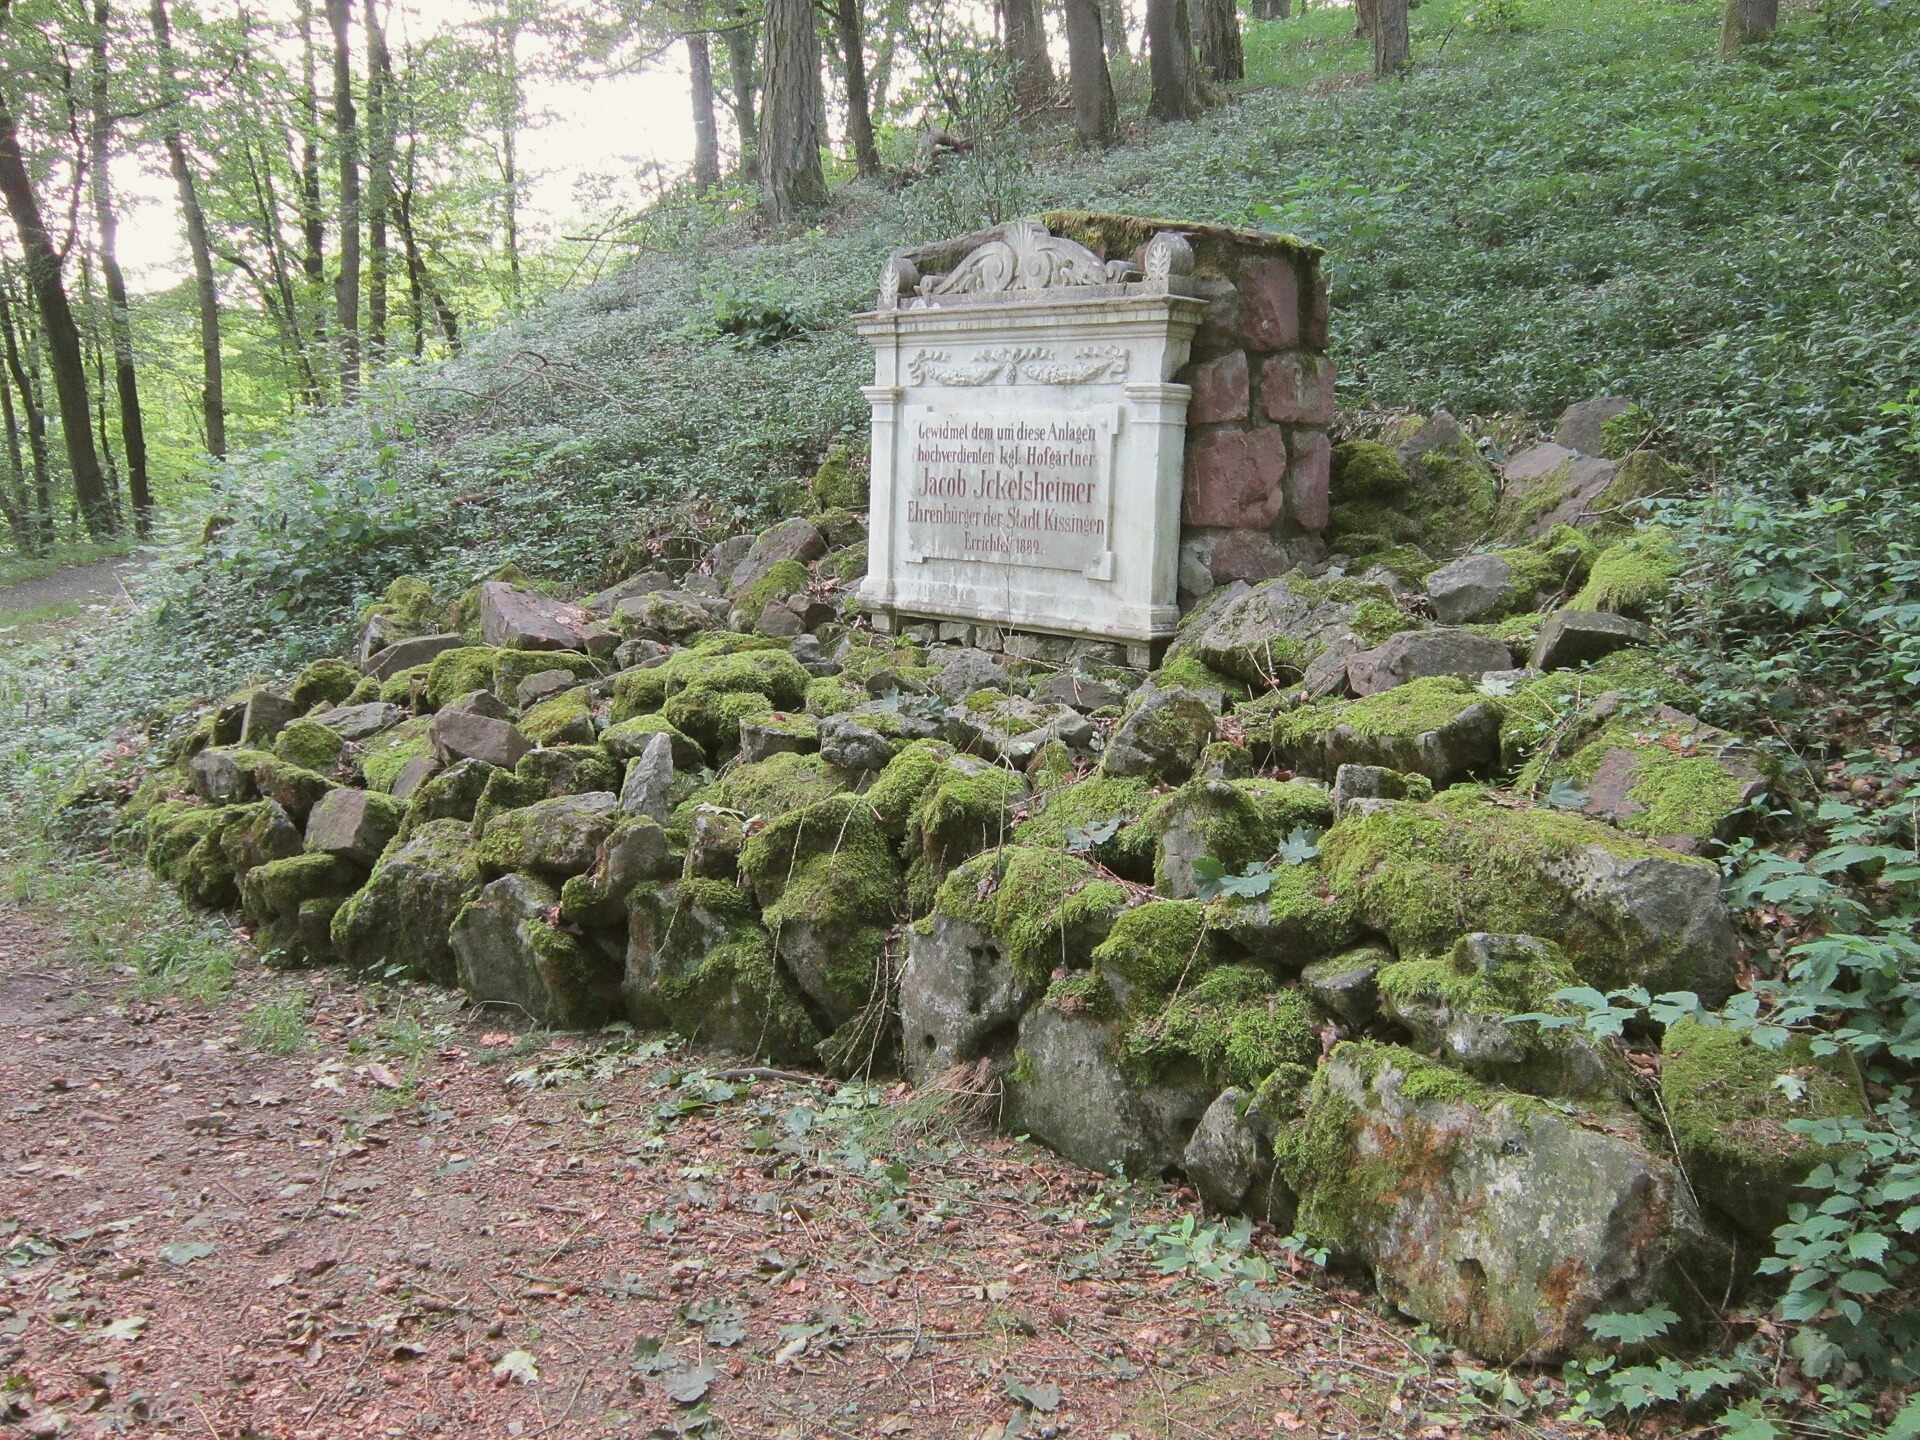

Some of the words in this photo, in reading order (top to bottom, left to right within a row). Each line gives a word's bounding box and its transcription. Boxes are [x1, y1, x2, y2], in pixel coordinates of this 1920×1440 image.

[919, 421, 968, 440] Gewidmet
[971, 422, 993, 441] dem
[997, 426, 1014, 441] um
[1016, 421, 1046, 441] diese
[1048, 421, 1096, 444] Anlagen
[917, 444, 994, 465] hochverdienten
[1026, 446, 1095, 469] Hofgärtner
[918, 468, 966, 497] Jacob
[908, 501, 980, 528] Ehrenbürger
[983, 506, 1003, 528] der
[1007, 506, 1041, 530] Stadt
[1044, 508, 1104, 536] Kissingen
